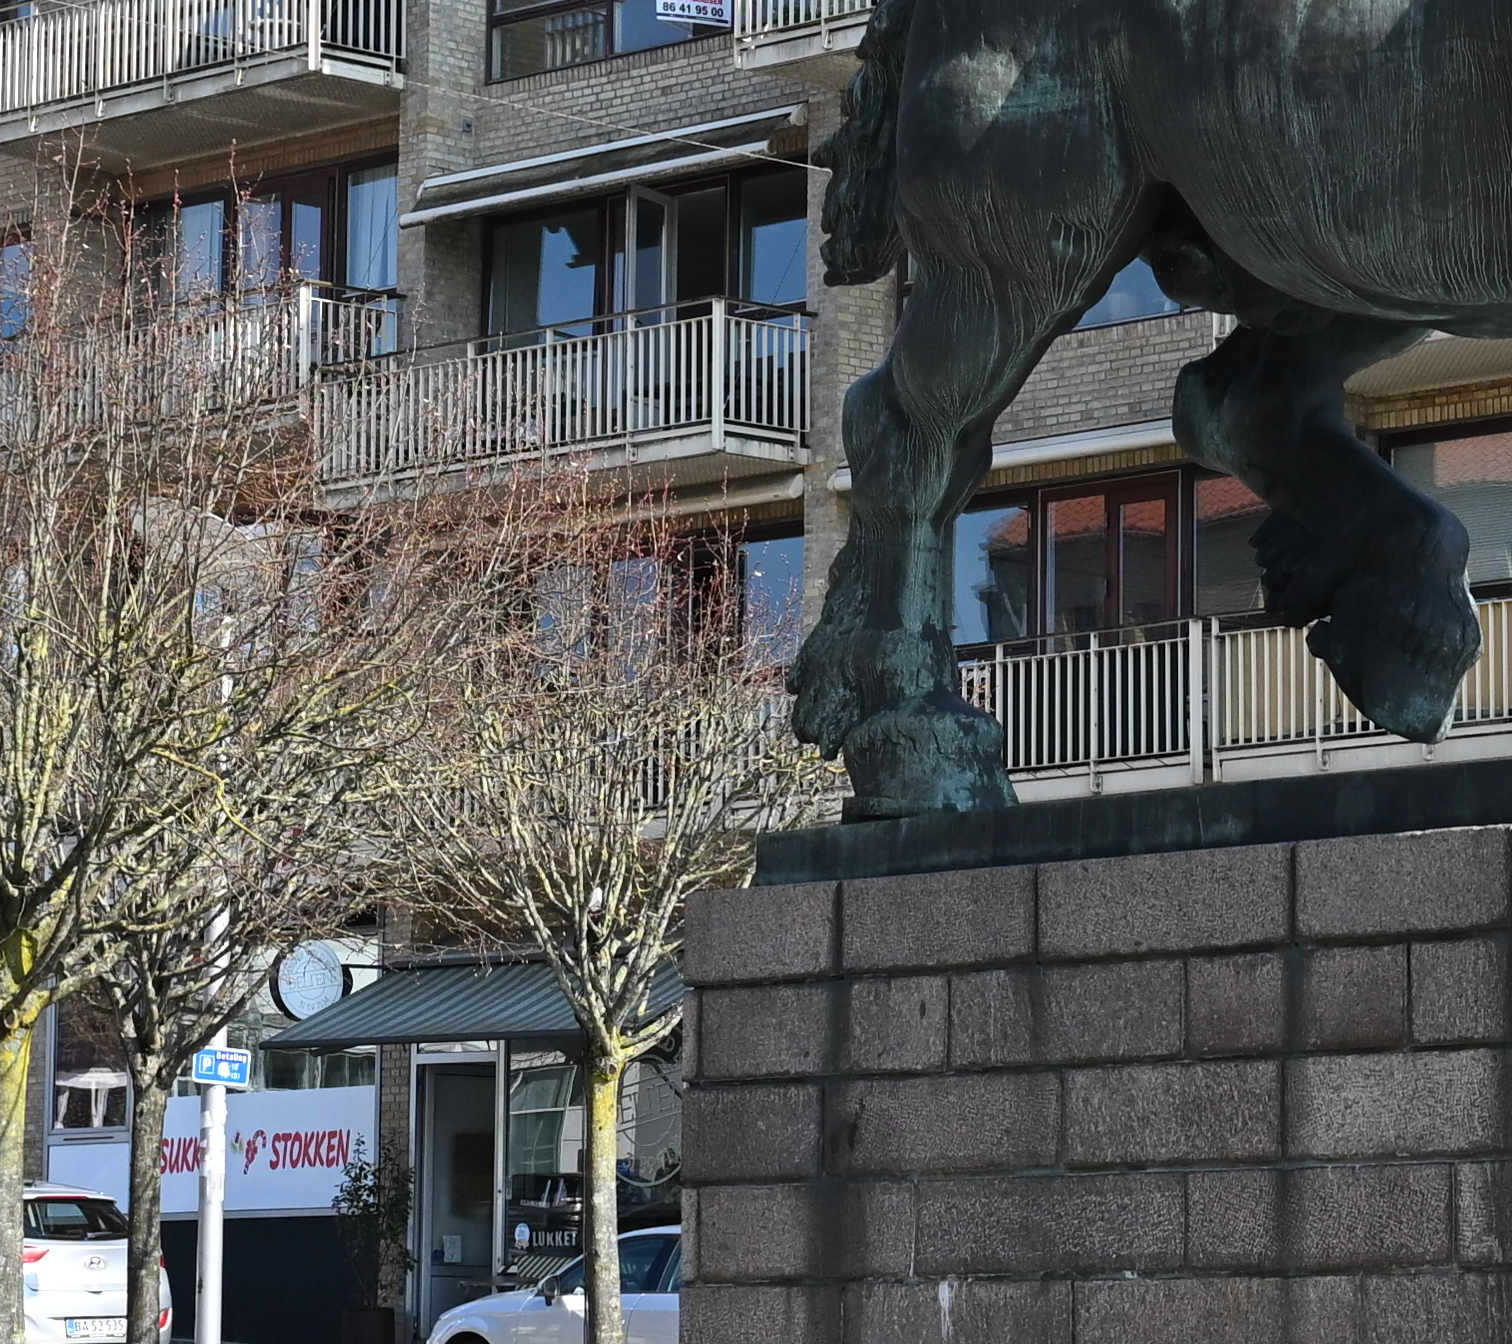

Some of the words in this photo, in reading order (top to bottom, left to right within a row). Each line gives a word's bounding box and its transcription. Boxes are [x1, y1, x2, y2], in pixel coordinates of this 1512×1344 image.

[662, 2, 676, 12] 86
[679, 3, 691, 13] 41
[695, 5, 708, 15] 95
[711, 7, 724, 17] 00
[202, 1056, 212, 1072] P
[216, 1051, 247, 1063] Betaling
[160, 1136, 201, 1174] SUKK
[269, 1129, 352, 1170] STOKKEN
[532, 1230, 578, 1247] LUKKET
[74, 1321, 89, 1332] BA
[91, 1320, 104, 1331] 52
